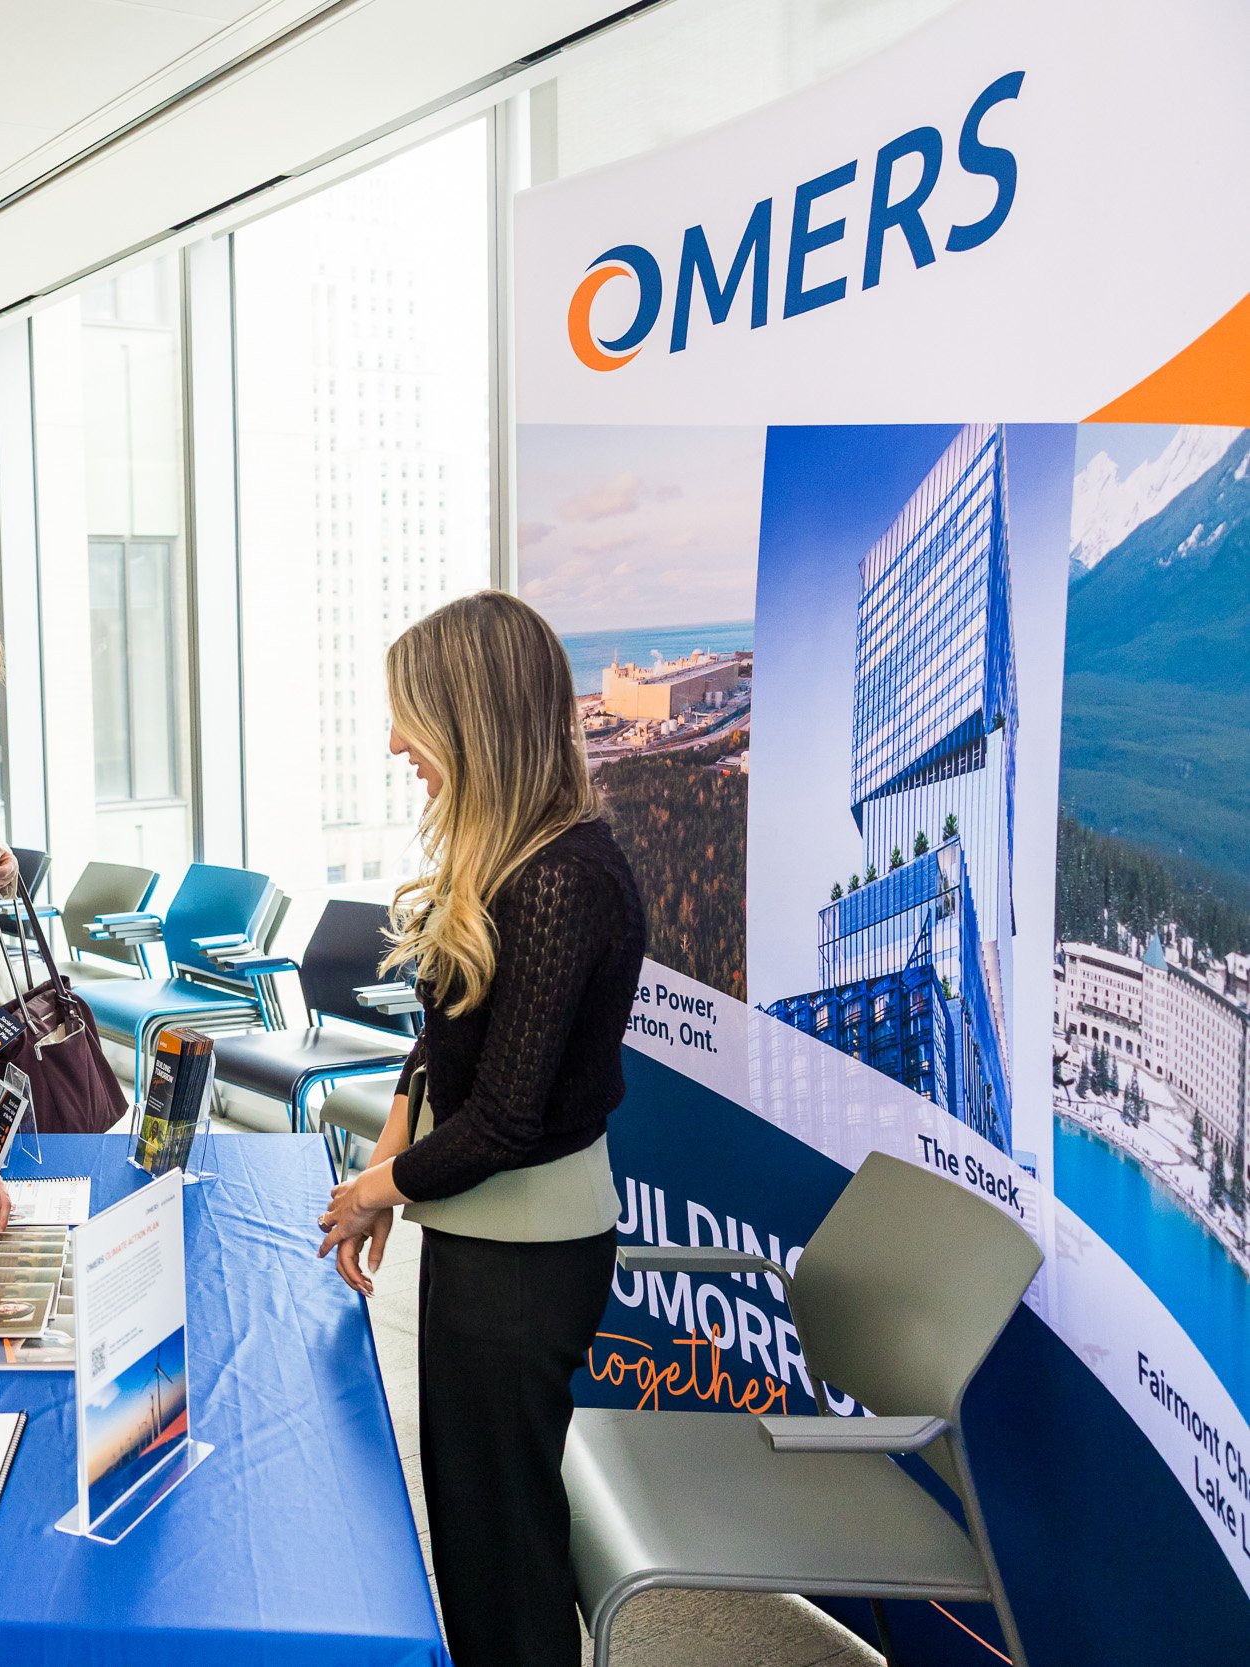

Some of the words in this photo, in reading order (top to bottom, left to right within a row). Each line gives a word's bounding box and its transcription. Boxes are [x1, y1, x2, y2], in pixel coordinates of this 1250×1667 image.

[568, 70, 1025, 371] OMERS
[10, 1024, 20, 1032] and
[625, 1013, 674, 1046] erton,
[680, 1022, 717, 1054] Ont.
[655, 983, 717, 1025] Power,
[918, 1133, 959, 1176] The
[965, 1155, 1024, 1219] Stack,
[615, 1176, 806, 1303] UILDIN
[588, 1322, 788, 1416] together
[611, 1258, 877, 1417] OMORR
[1138, 1350, 1221, 1466] Fairmont
[1225, 1440, 1250, 1501] Ch
[1194, 1455, 1237, 1537] Lake
